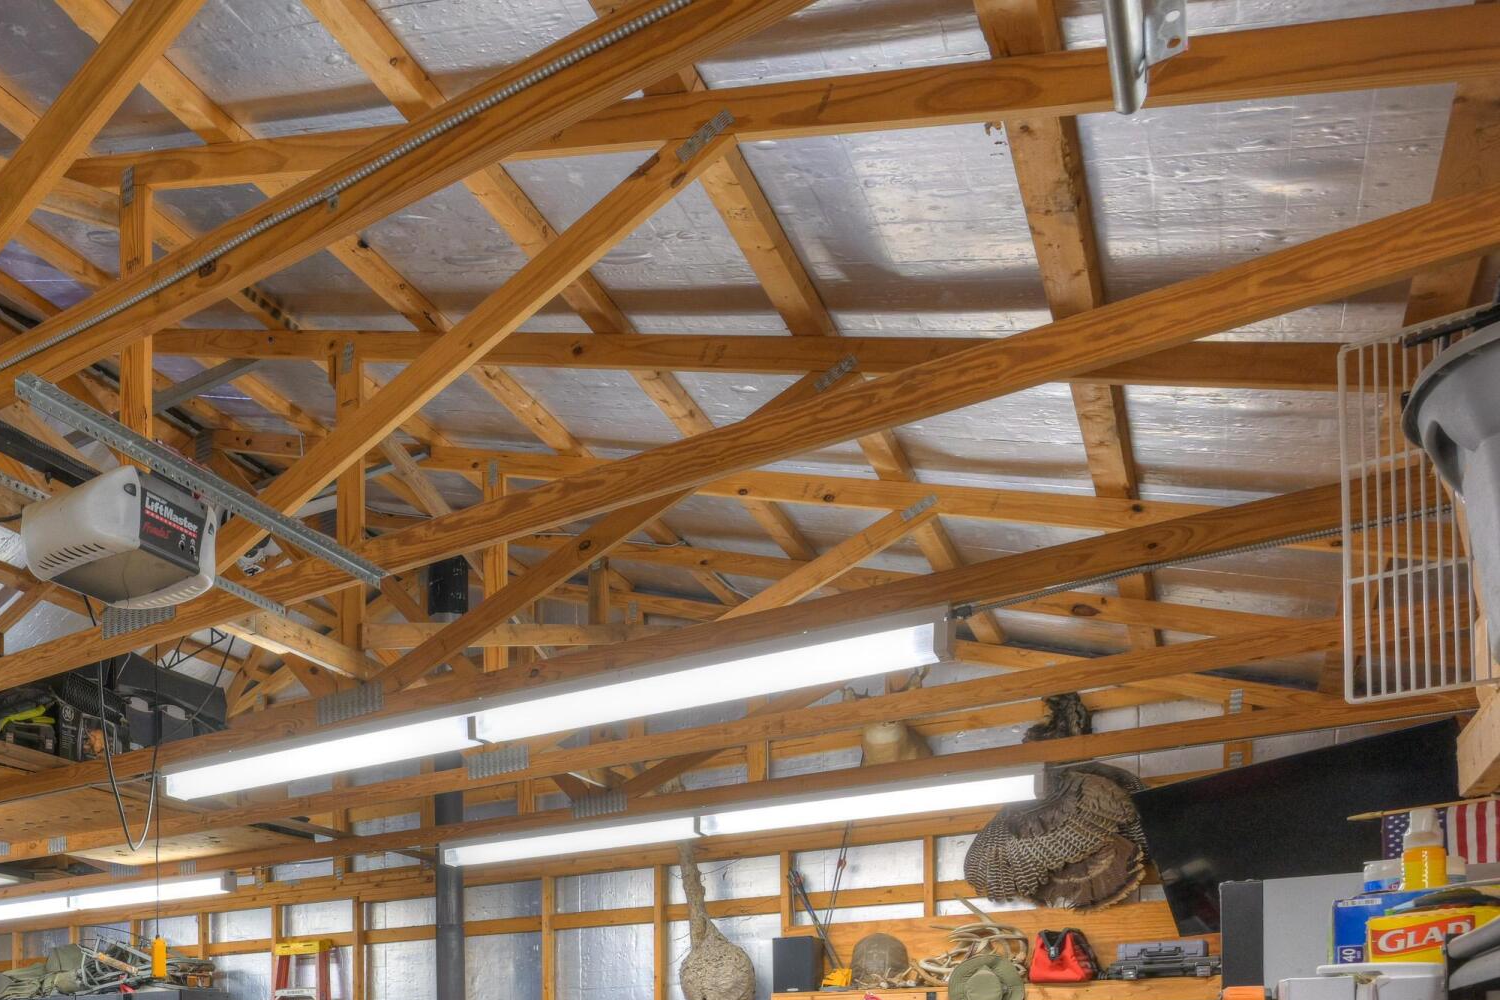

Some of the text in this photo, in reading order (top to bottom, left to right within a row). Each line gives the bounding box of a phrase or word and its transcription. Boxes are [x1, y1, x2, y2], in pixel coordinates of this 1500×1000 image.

[145, 496, 199, 533] LiftMaster
[1377, 919, 1473, 953] GLAD
[1342, 947, 1356, 963] 40
